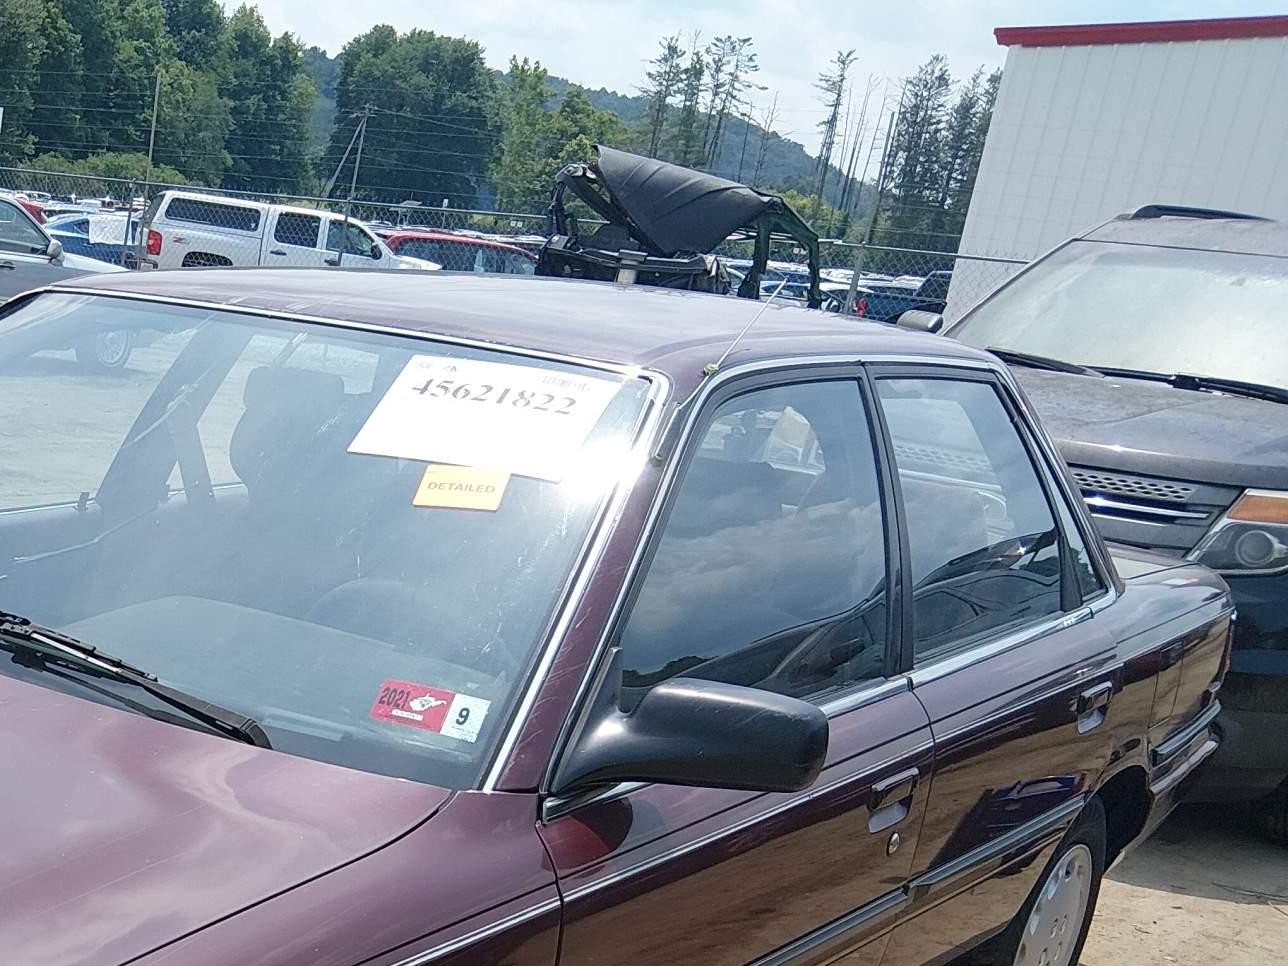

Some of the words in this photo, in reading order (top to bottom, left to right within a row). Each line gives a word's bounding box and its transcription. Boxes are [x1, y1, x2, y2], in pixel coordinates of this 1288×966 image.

[412, 378, 576, 415] 45621822
[427, 481, 495, 494] DETAILED
[378, 687, 411, 709] 2021
[455, 707, 471, 726] 9
